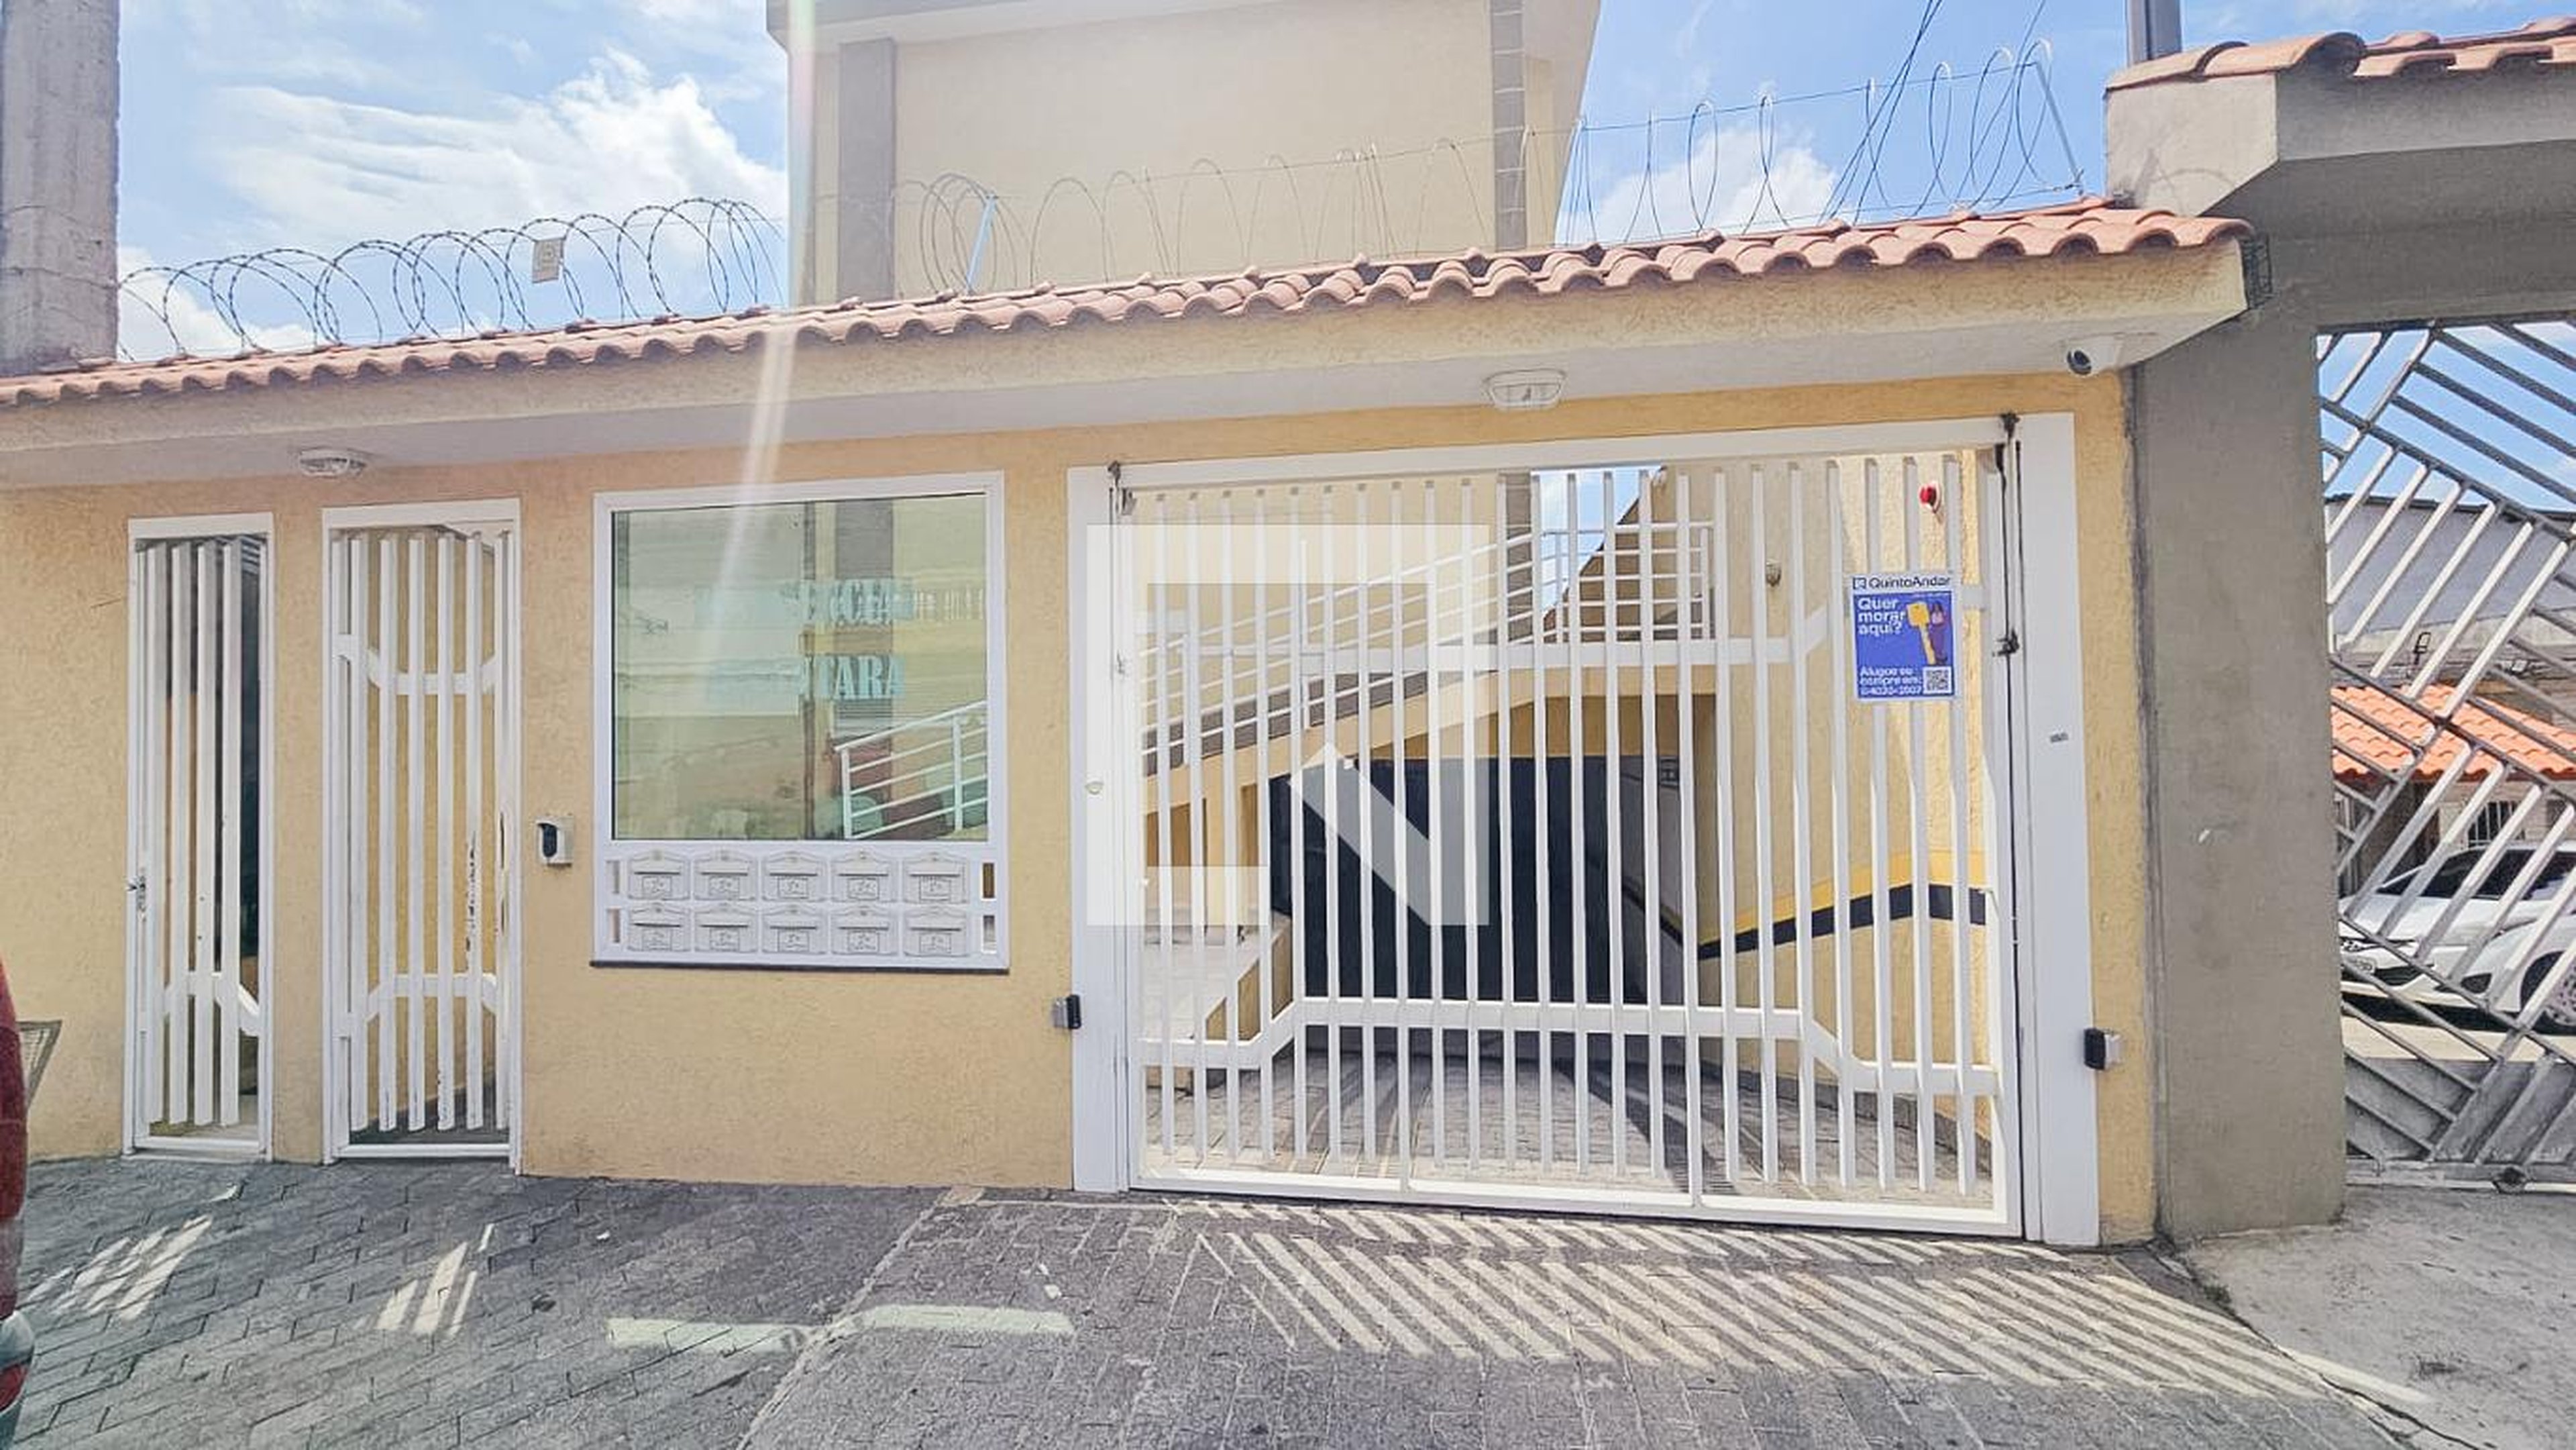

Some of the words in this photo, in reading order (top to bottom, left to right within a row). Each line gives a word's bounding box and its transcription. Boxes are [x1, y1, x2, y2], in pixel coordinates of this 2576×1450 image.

[1869, 576, 1951, 588] QuintoAndar
[1858, 597, 1899, 611] Quer
[1858, 610, 1907, 623] morar
[1858, 620, 1902, 637] aqui?
